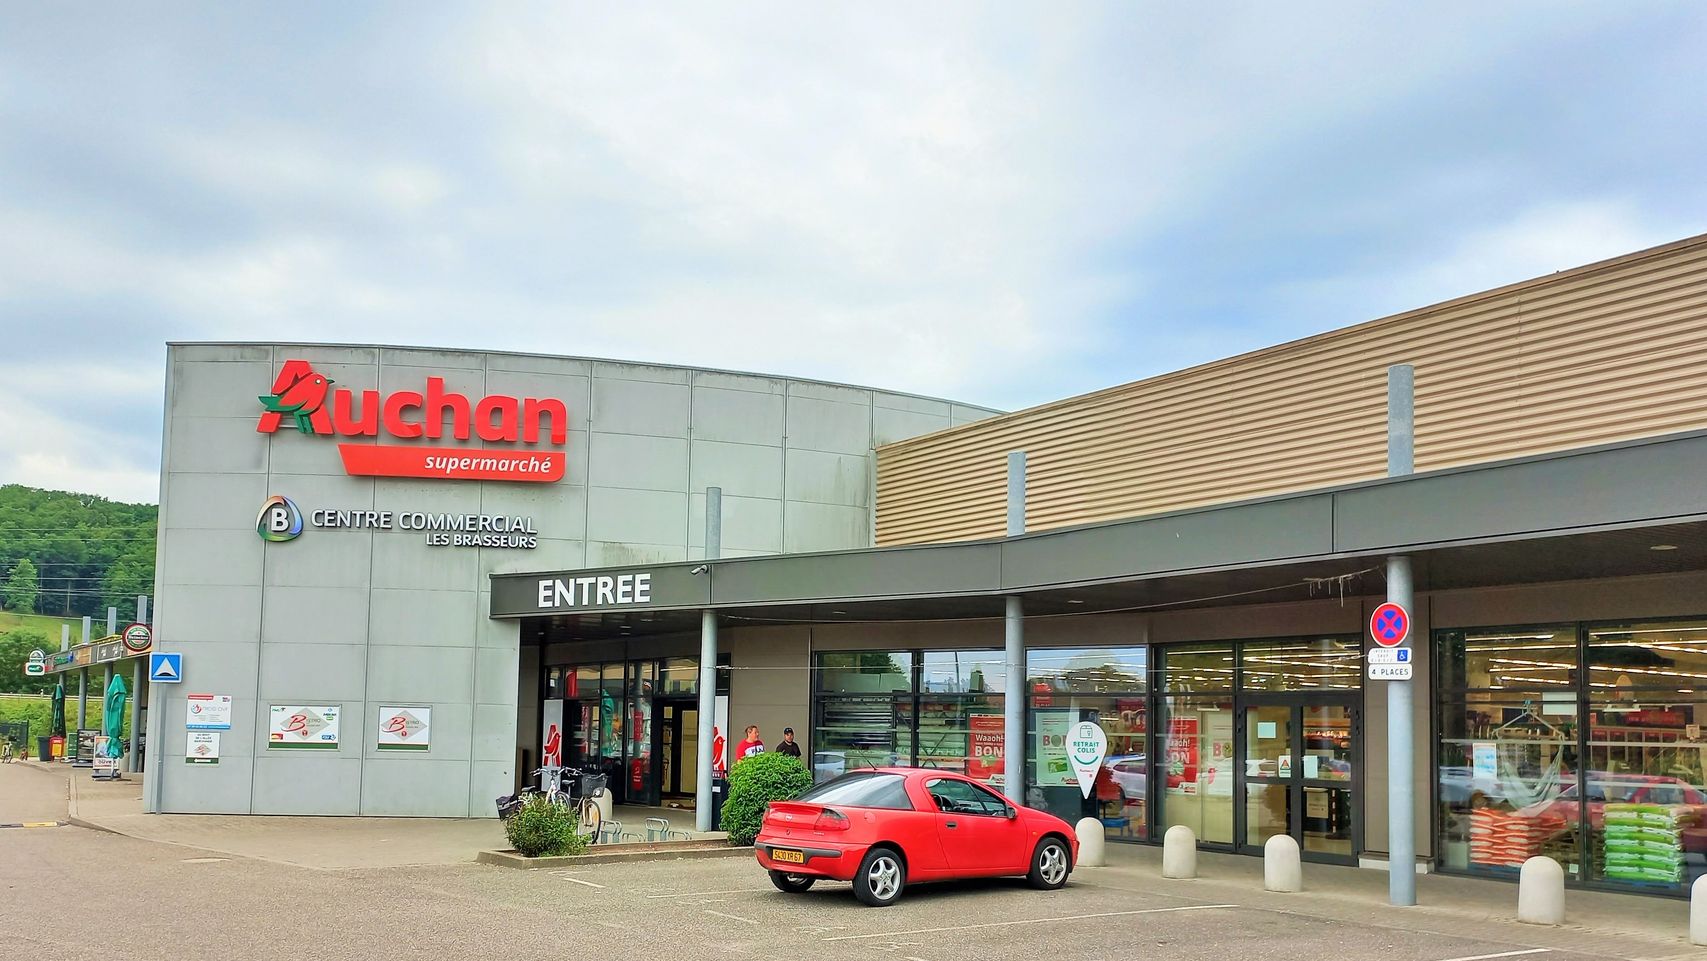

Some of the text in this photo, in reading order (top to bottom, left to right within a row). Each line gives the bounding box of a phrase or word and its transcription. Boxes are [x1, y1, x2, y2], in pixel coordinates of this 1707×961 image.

[256, 360, 568, 445] Auchan
[424, 453, 551, 475] supermarché
[270, 508, 289, 532] B
[311, 509, 538, 535] CENTRE COMMERCIAL
[426, 533, 538, 549] LES BRASSEURS
[537, 573, 651, 608] ENTREE
[1380, 668, 1409, 676] PLACES
[975, 745, 1003, 758] BON
